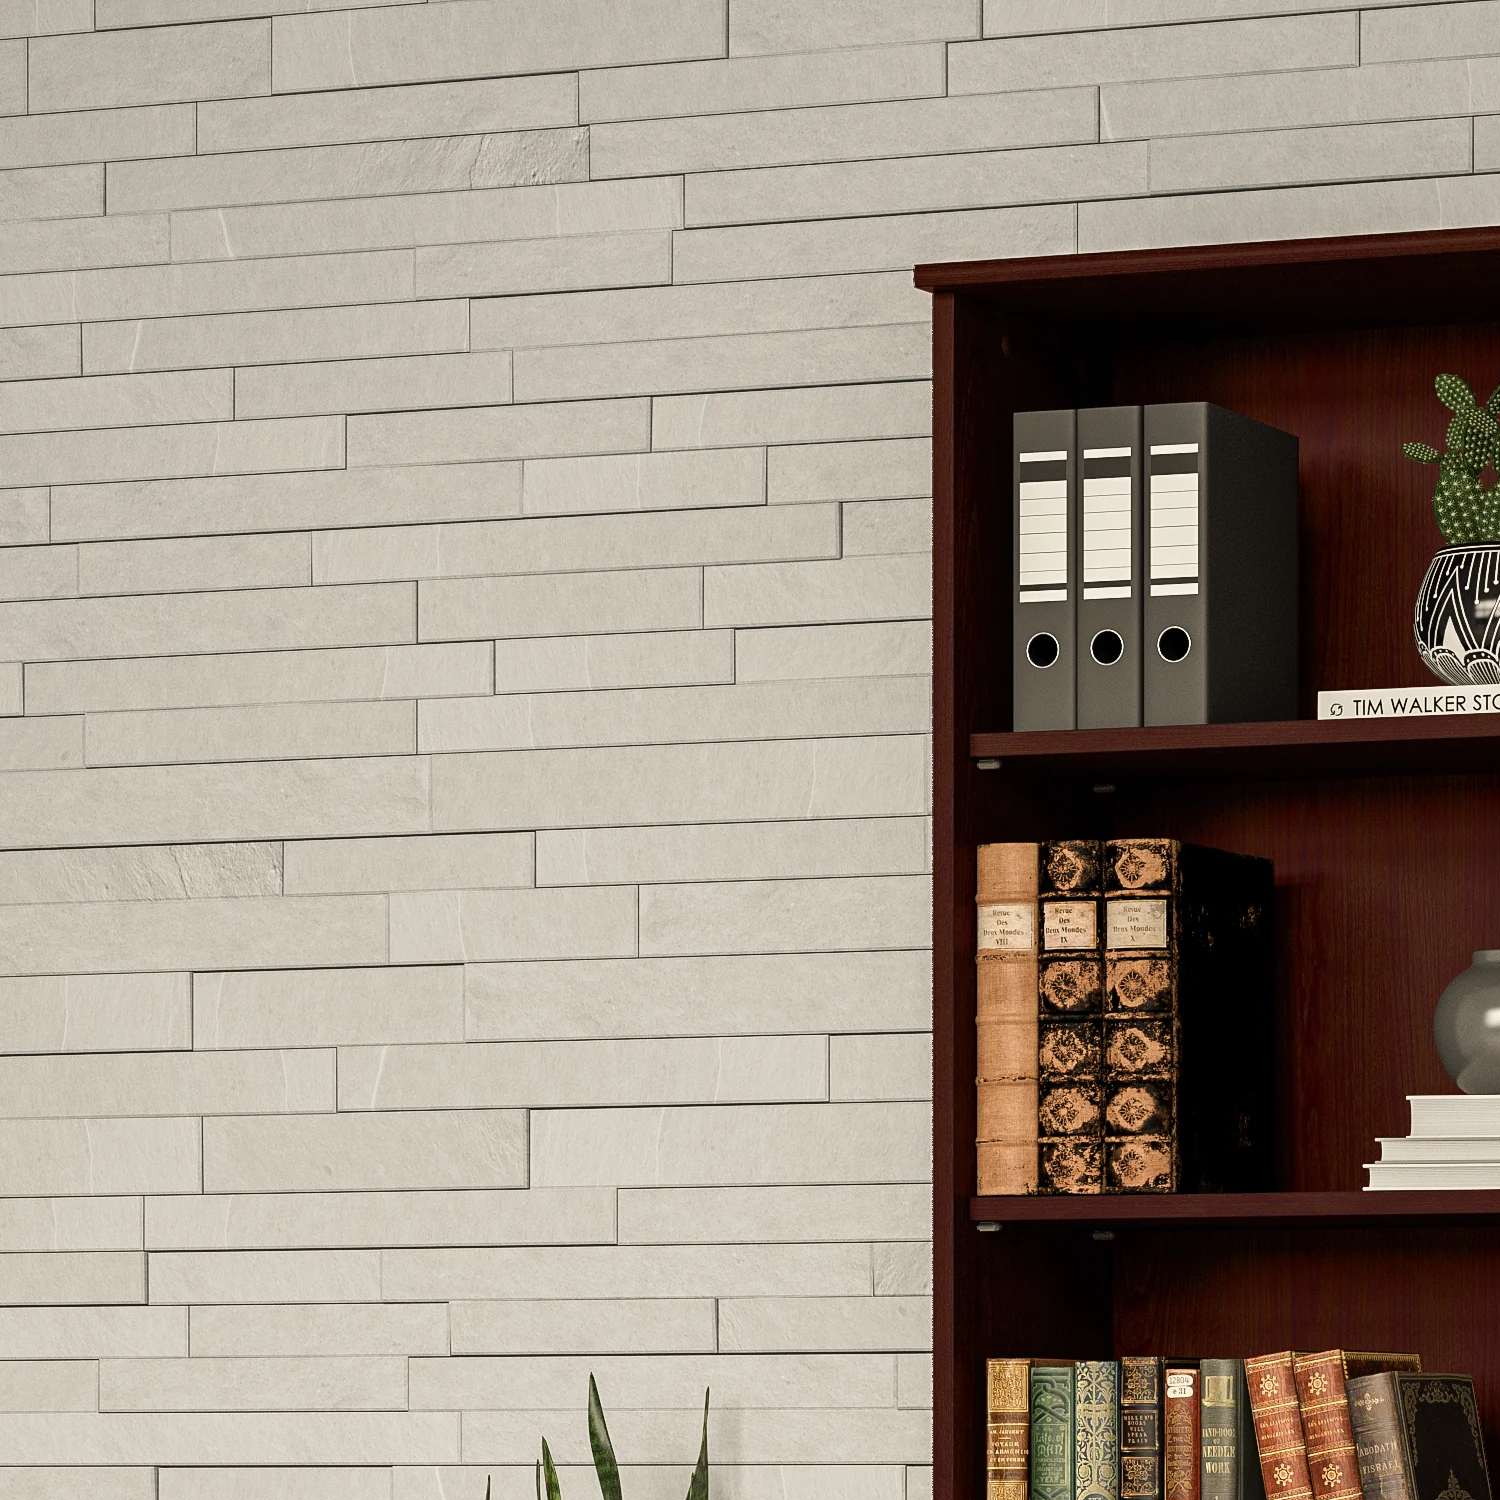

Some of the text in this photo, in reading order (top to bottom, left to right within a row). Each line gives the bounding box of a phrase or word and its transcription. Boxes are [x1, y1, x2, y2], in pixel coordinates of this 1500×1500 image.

[1353, 698, 1384, 716] TIM
[1390, 695, 1466, 715] WALKER
[1168, 1377, 1190, 1385] 12804
[1178, 1387, 1187, 1395] 31
[1205, 1461, 1231, 1474] WORK
